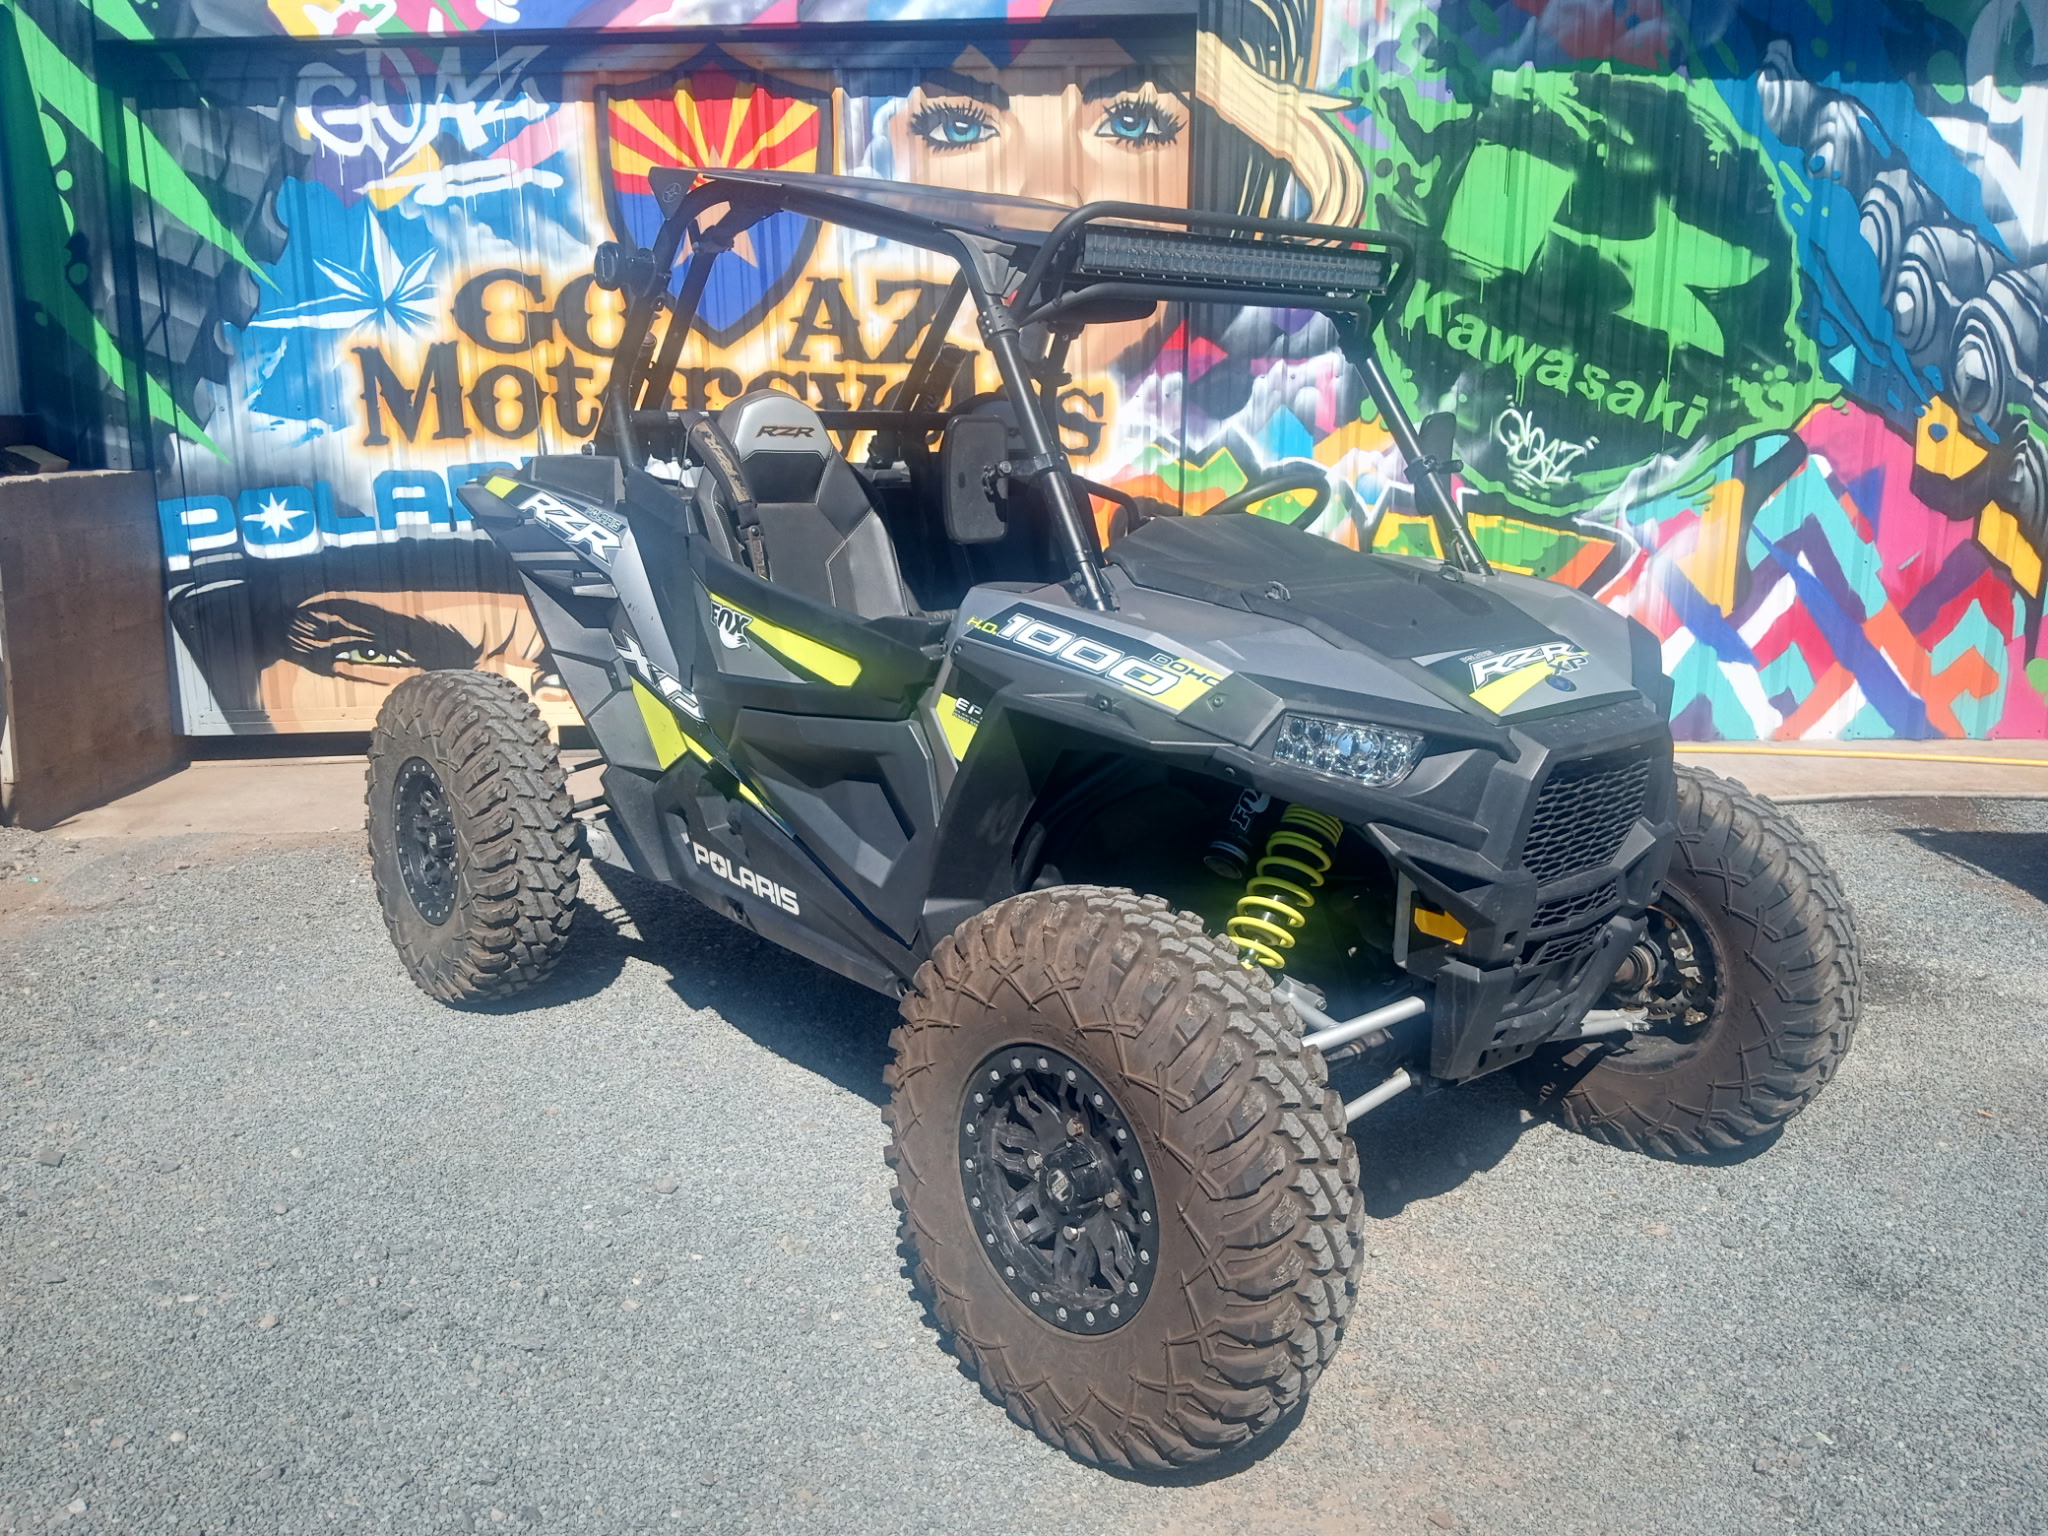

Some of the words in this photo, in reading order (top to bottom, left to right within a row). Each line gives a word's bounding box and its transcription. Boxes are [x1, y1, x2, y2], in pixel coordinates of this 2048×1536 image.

[1398, 278, 1710, 440] Kawasaki
[755, 424, 816, 439] RZR
[517, 490, 624, 567] RZR
[584, 504, 623, 532] POLARIS
[710, 602, 753, 640] FOX
[997, 612, 1183, 697] 1000
[1149, 652, 1221, 688] DOHC
[1468, 640, 1576, 692] RZR
[1547, 655, 1589, 676] XP
[955, 697, 984, 715] EP
[692, 841, 801, 916] POLARIS
